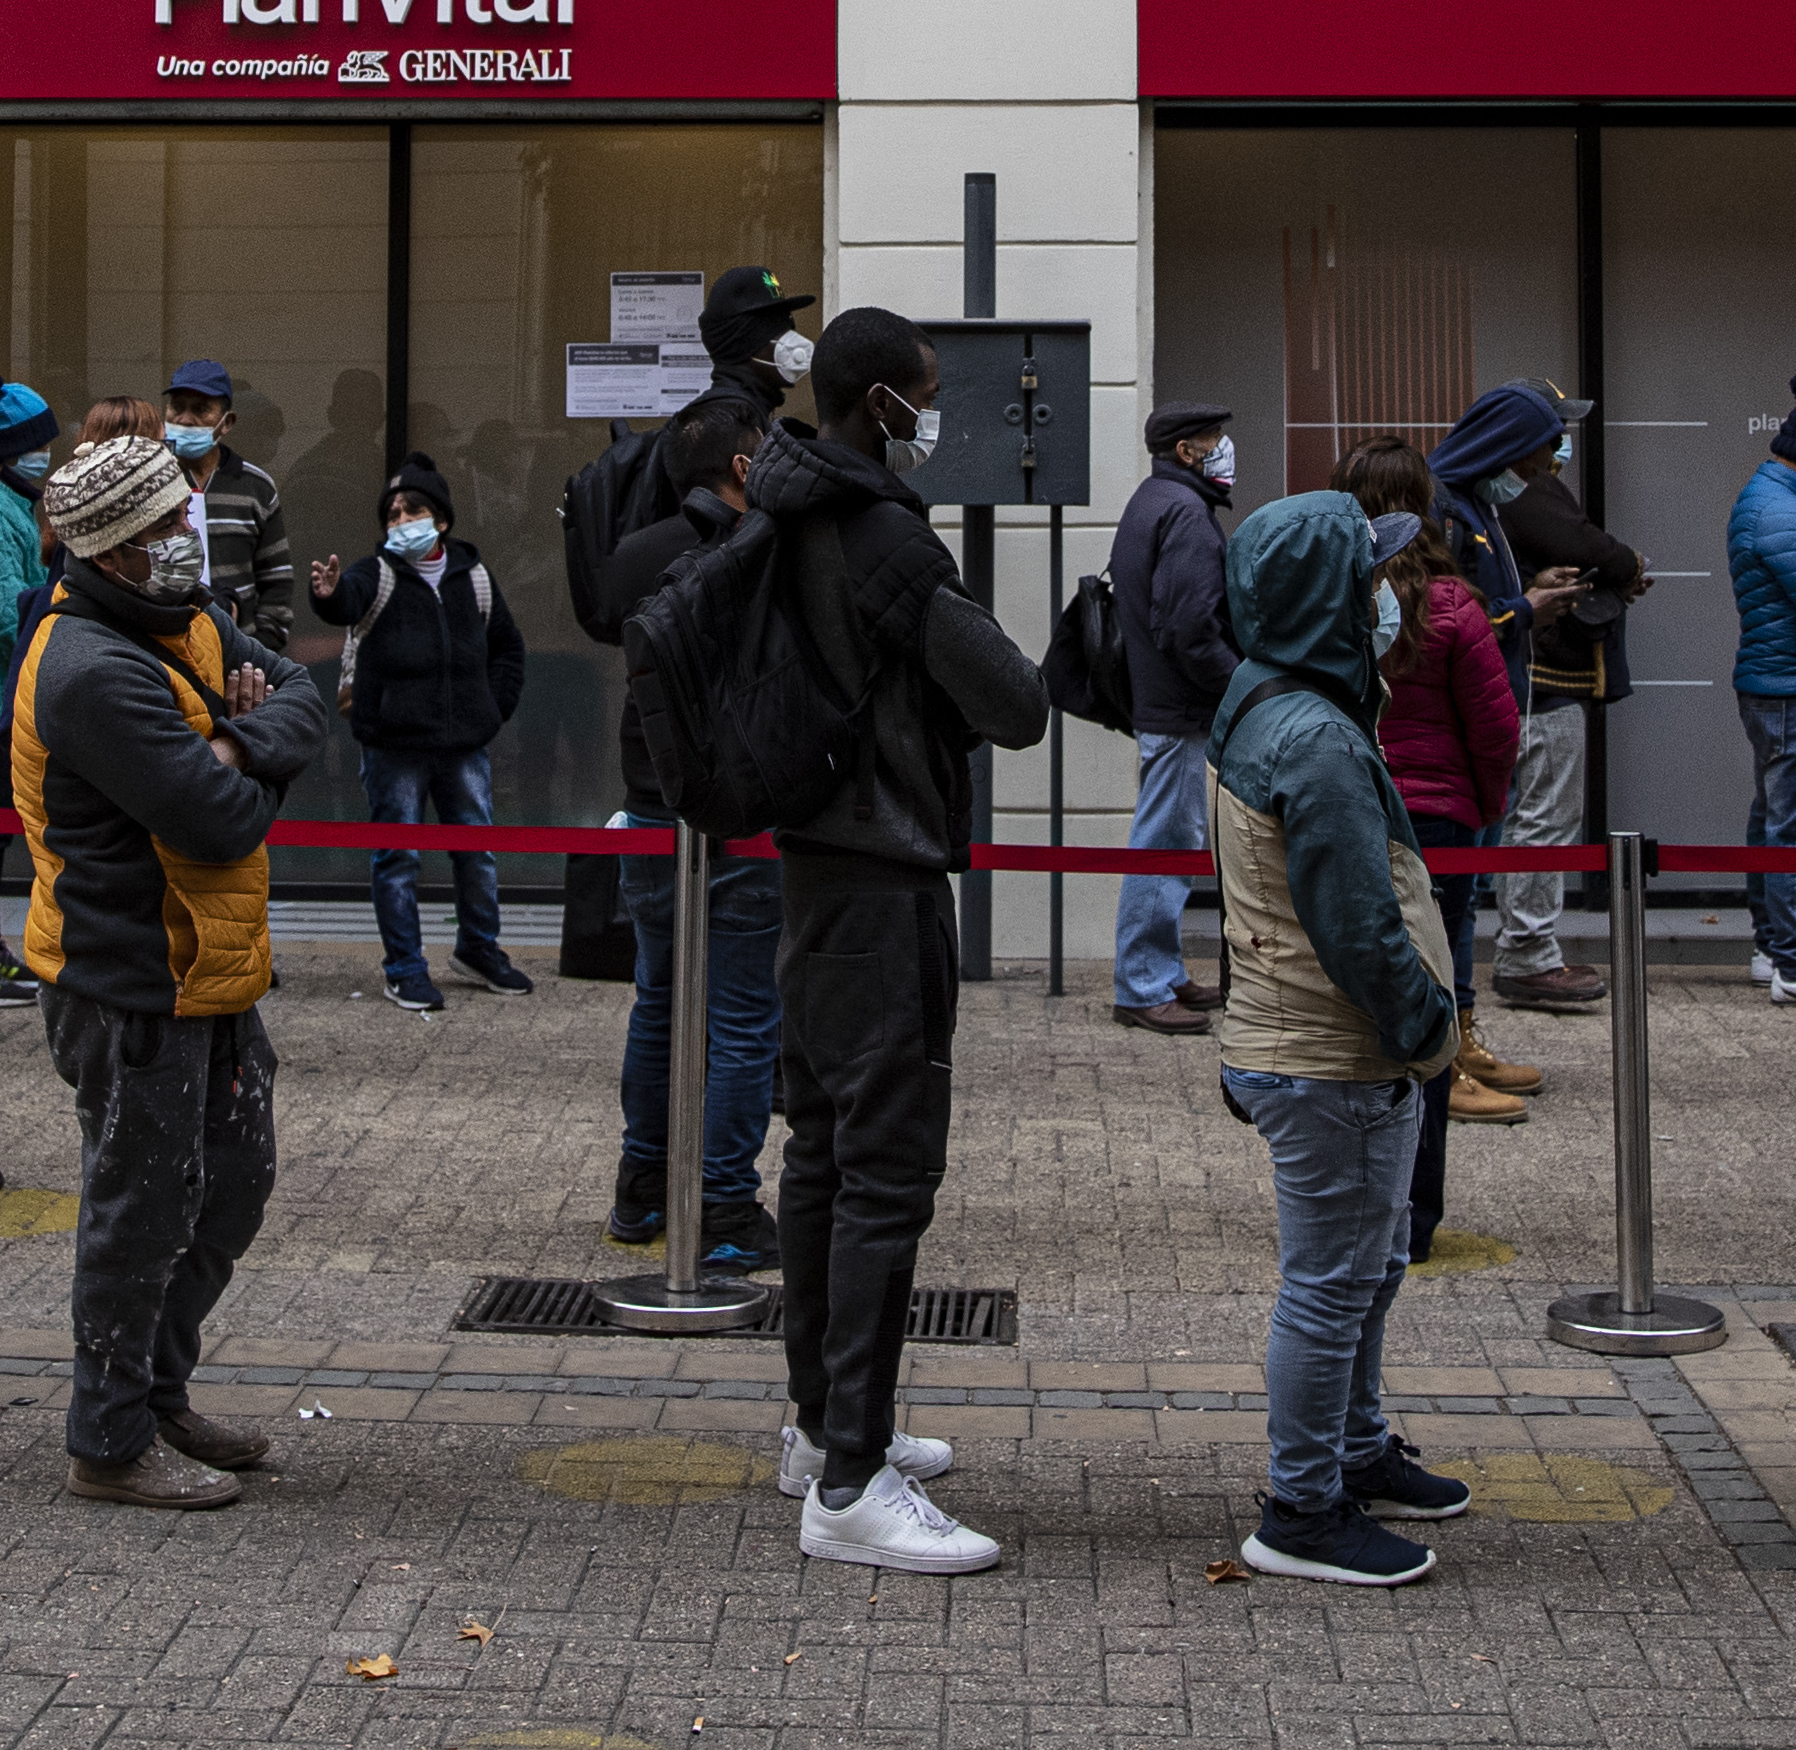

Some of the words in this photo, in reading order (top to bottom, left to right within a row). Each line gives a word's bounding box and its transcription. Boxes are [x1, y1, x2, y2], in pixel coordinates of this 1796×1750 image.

[156, 55, 206, 78] Una
[211, 54, 331, 83] compañía
[399, 48, 574, 83] GENERALI
